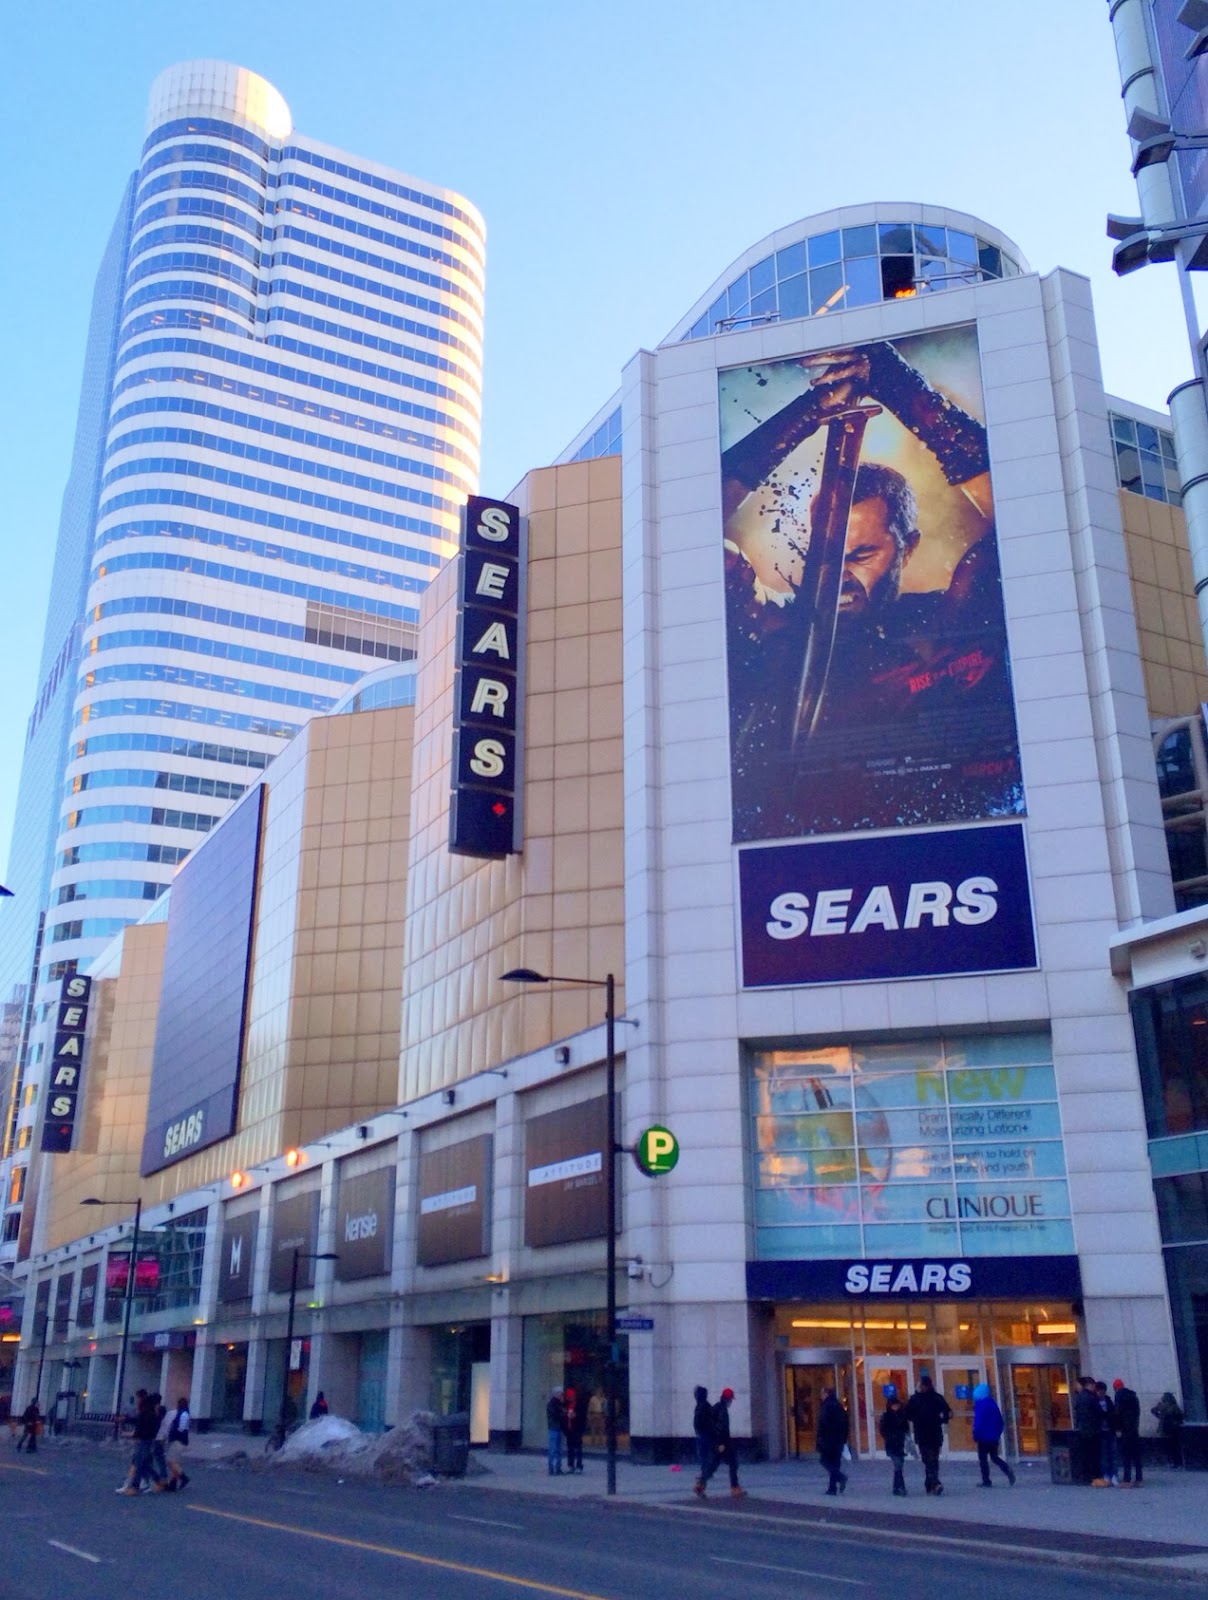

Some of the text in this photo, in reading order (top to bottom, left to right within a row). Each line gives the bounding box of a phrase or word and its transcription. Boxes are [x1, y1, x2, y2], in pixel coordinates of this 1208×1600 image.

[470, 507, 511, 778] SEARS
[766, 876, 999, 940] SEARS
[51, 978, 87, 1117] SEARS
[163, 1110, 204, 1158] SEARS
[648, 1131, 674, 1163] P
[925, 1193, 1045, 1219] CLINIQUE
[845, 1263, 972, 1294] SEARS
